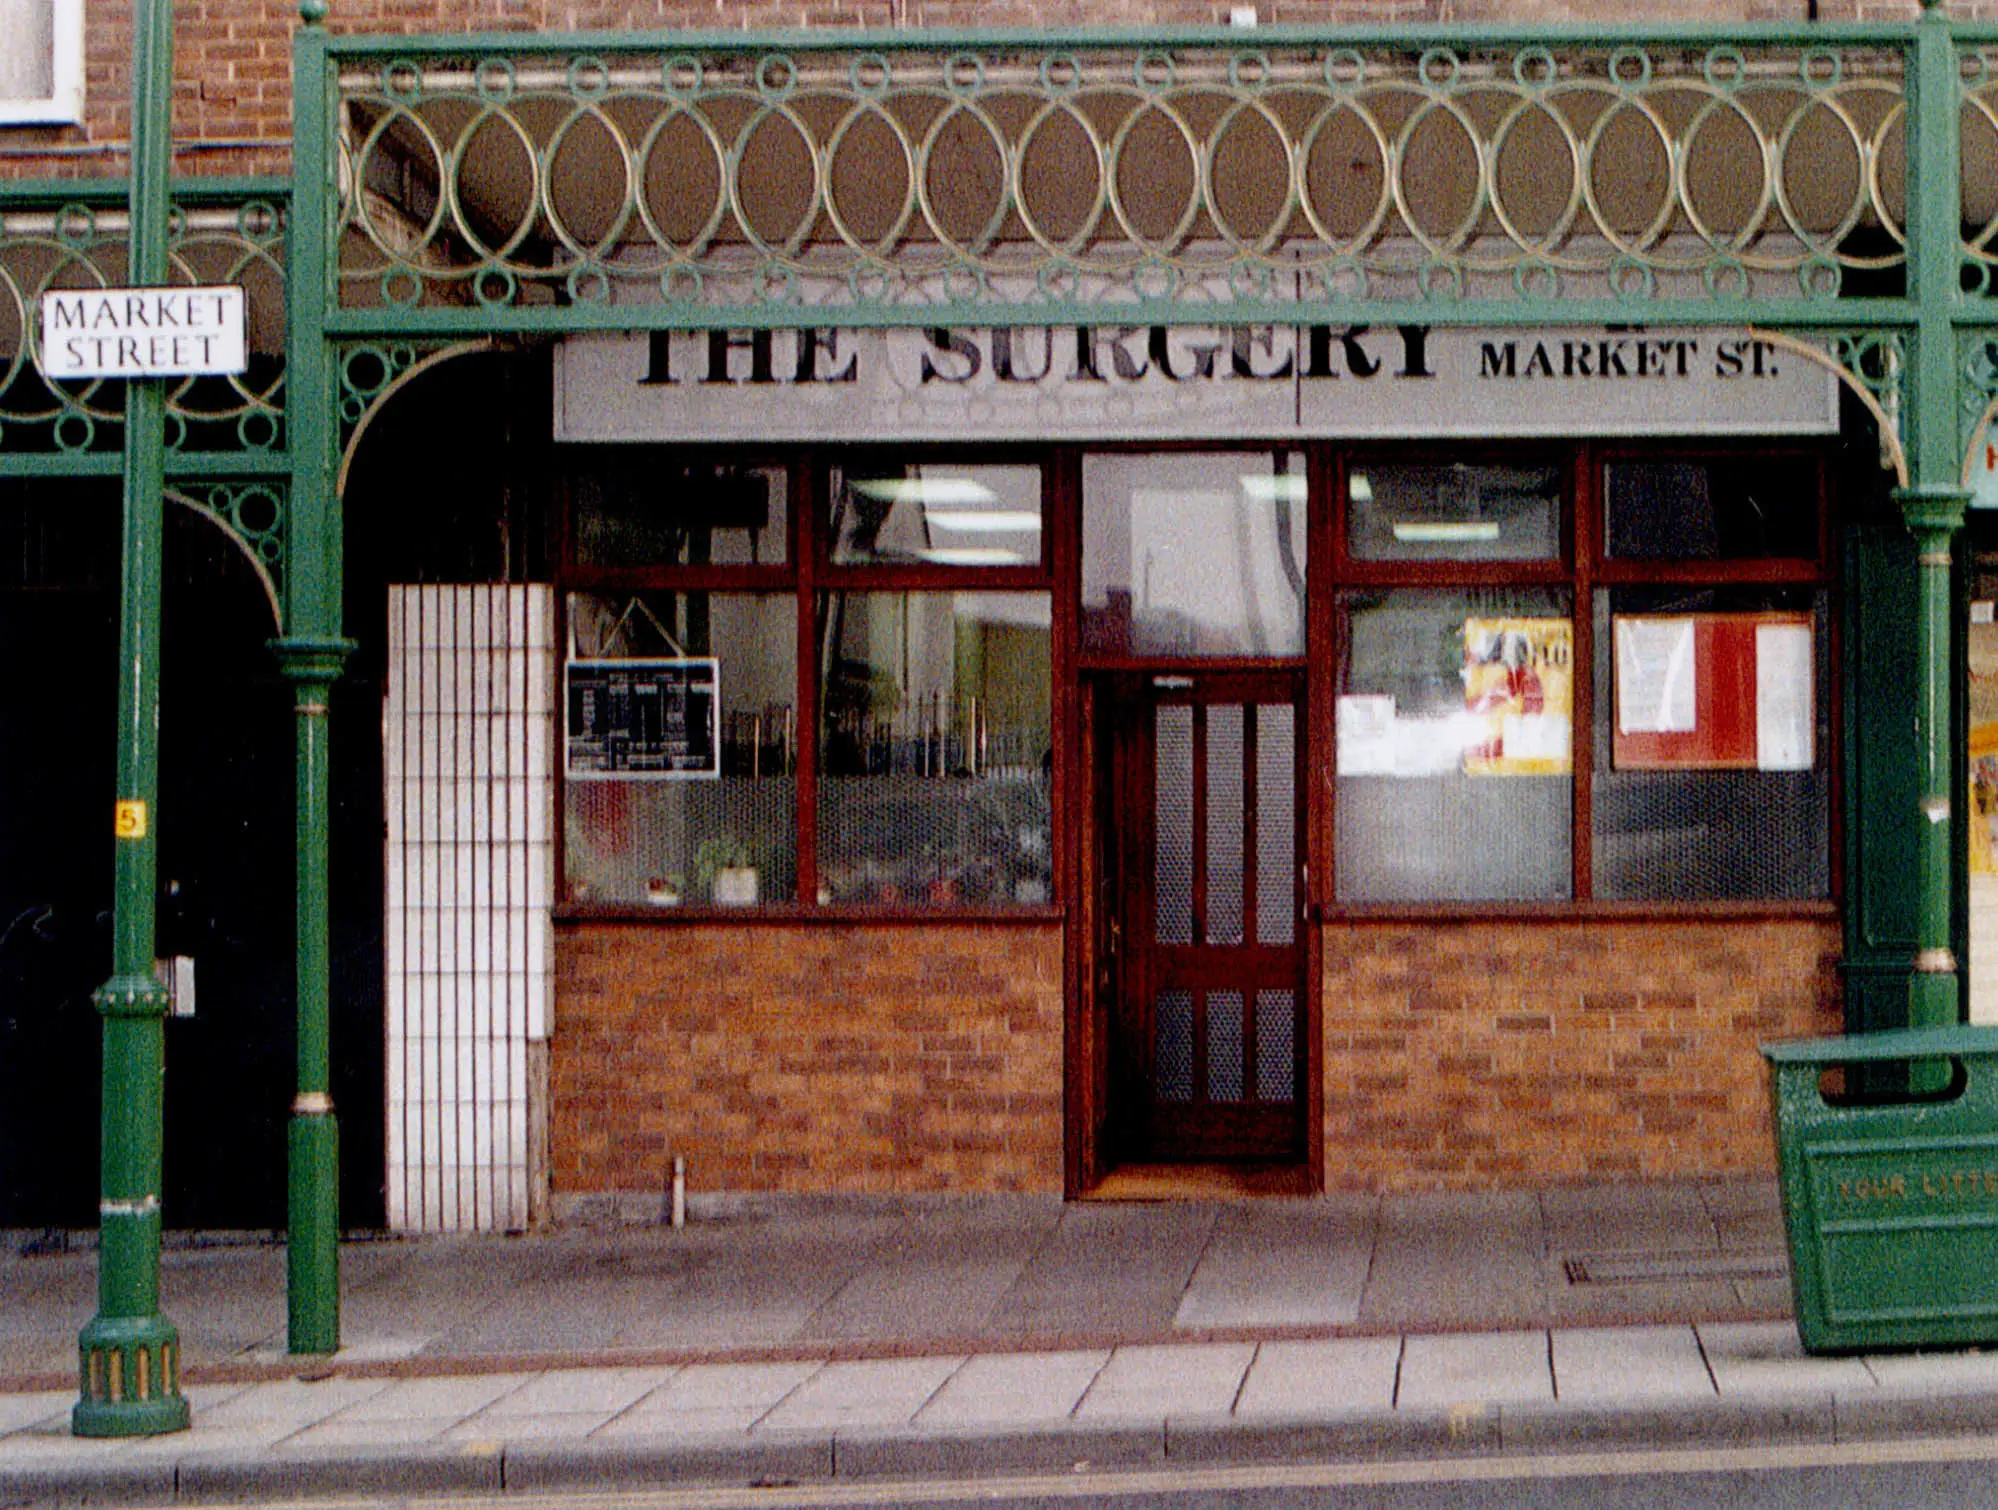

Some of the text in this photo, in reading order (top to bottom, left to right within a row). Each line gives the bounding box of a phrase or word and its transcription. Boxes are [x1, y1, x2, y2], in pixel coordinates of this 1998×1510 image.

[54, 295, 233, 328] MARKET
[66, 334, 221, 369] STREET
[637, 324, 1779, 385] THE SURGERY MARKET ST.
[119, 808, 137, 831] 5
[1839, 1174, 1906, 1200] YOUR
